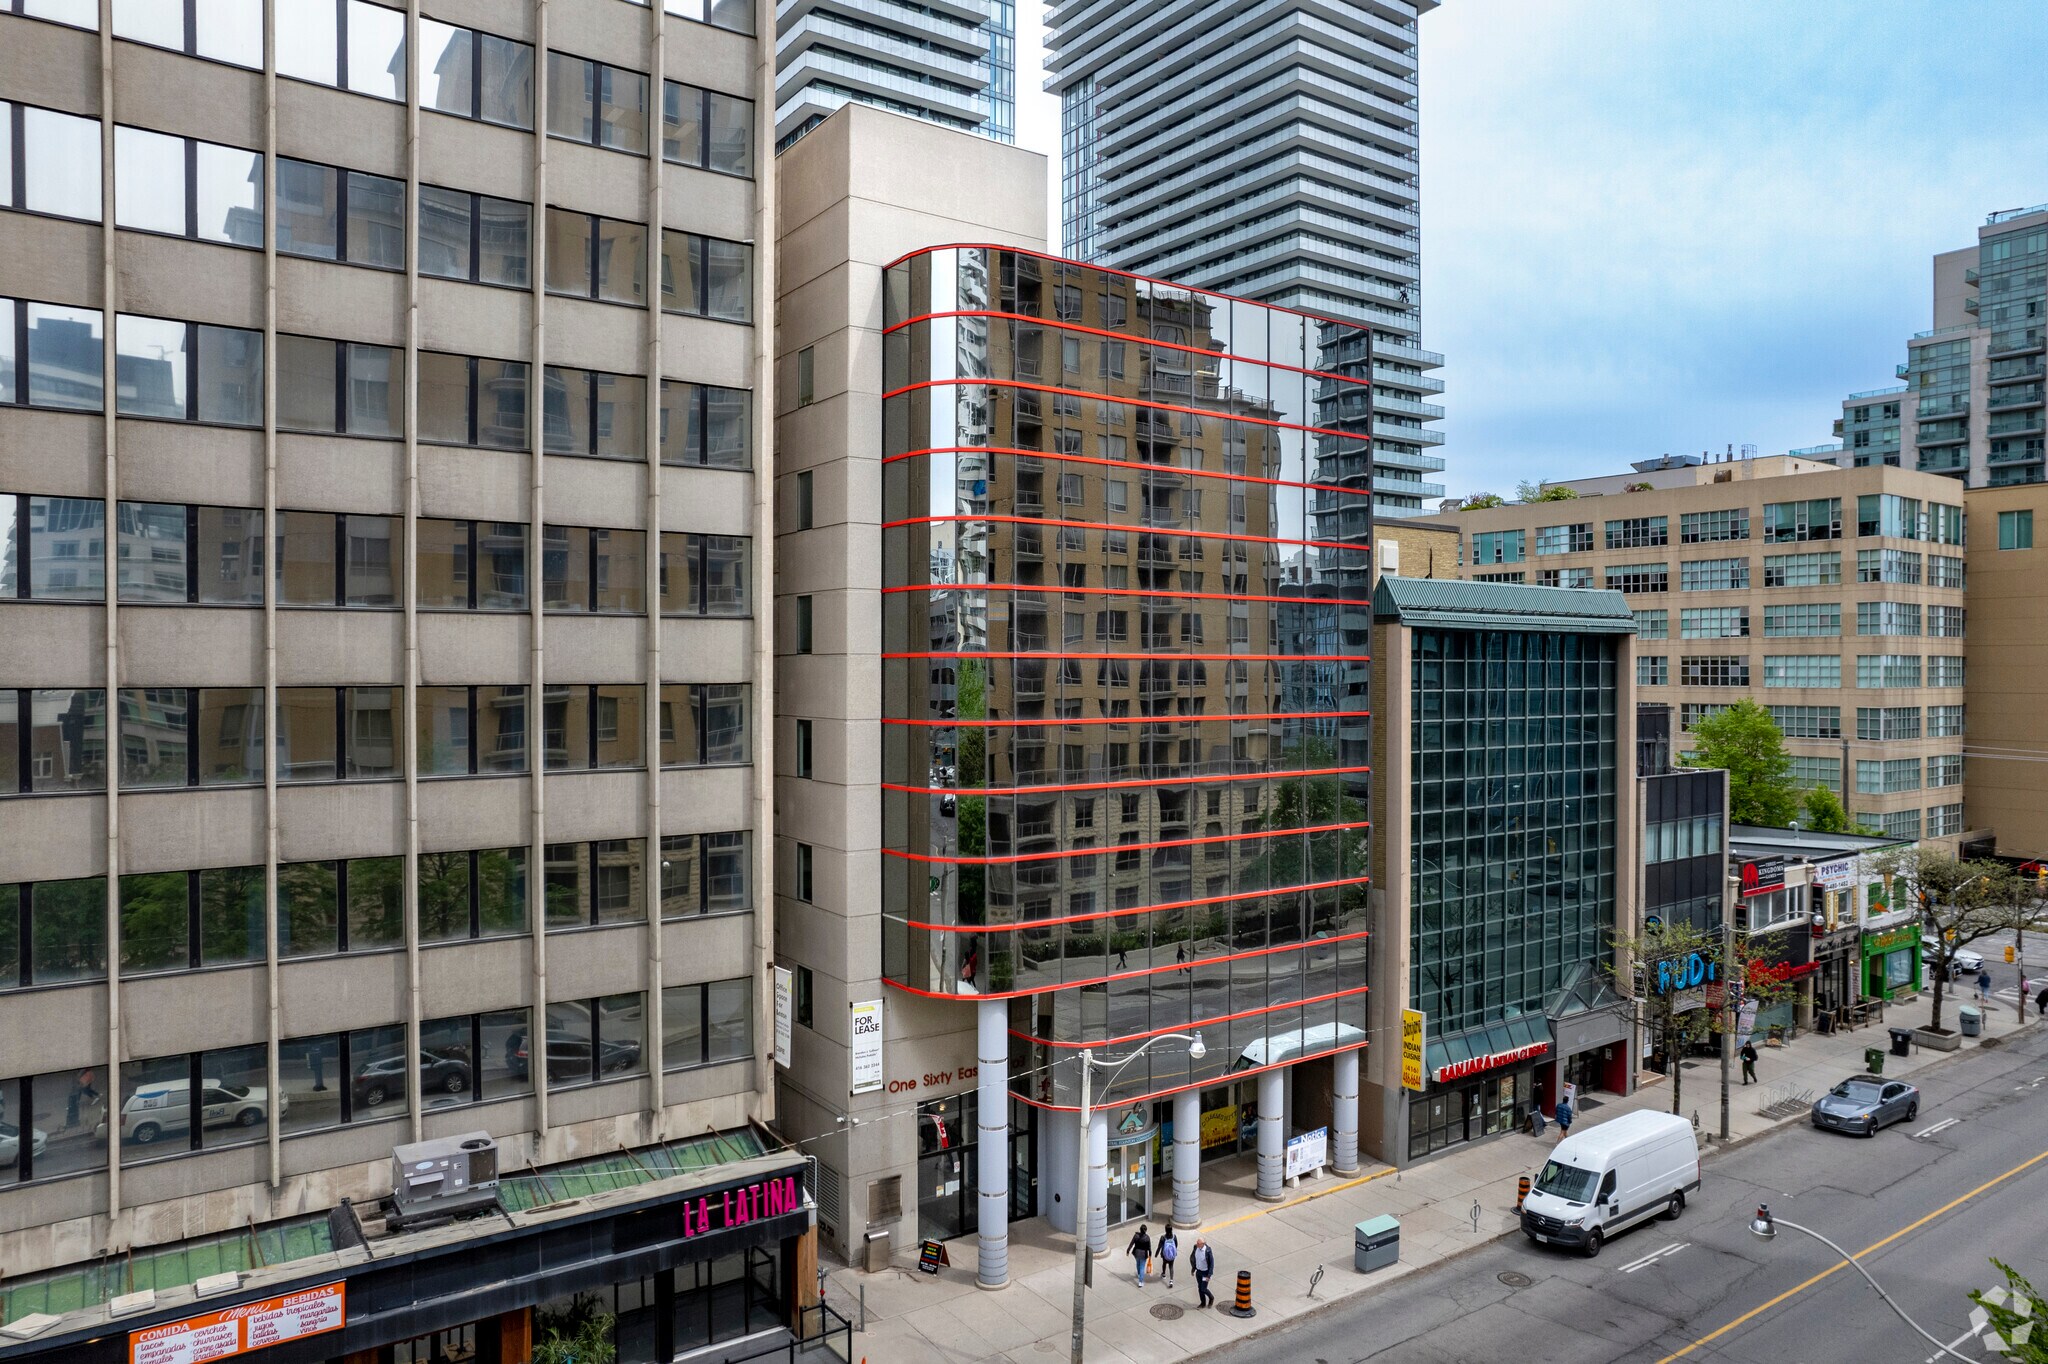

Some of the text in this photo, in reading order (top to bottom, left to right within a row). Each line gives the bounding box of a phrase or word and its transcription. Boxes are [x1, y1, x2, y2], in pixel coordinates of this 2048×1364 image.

[1758, 865, 1784, 876] KINGDOMS
[1821, 862, 1849, 876] PSYCHIC
[855, 1016, 873, 1027] FOR
[855, 1023, 880, 1035] LEASE
[1403, 1041, 1421, 1053] INDIAN
[1403, 1051, 1421, 1062] CUISINE
[1439, 1042, 1548, 1083] BANJARA INDIAN CUISINE
[889, 1079, 917, 1094] One
[923, 1070, 953, 1087] Sixty
[958, 1066, 978, 1081] Eas
[1301, 1130, 1325, 1142] Notice
[684, 1177, 798, 1238] LA LATINA
[283, 1287, 334, 1307] BEBIDAS
[219, 1303, 271, 1321] Menu
[253, 1300, 326, 1324] bebidas tropicales
[300, 1306, 339, 1321] margaritas
[253, 1321, 275, 1333] jugos
[300, 1315, 328, 1328] sangria
[139, 1323, 191, 1342] COMIDA
[194, 1324, 228, 1338] ceviches
[300, 1325, 318, 1334] vinos
[140, 1340, 165, 1352] tacos
[193, 1332, 233, 1346] churrasco
[140, 1343, 187, 1360] empanadas
[193, 1338, 237, 1355] carne asada
